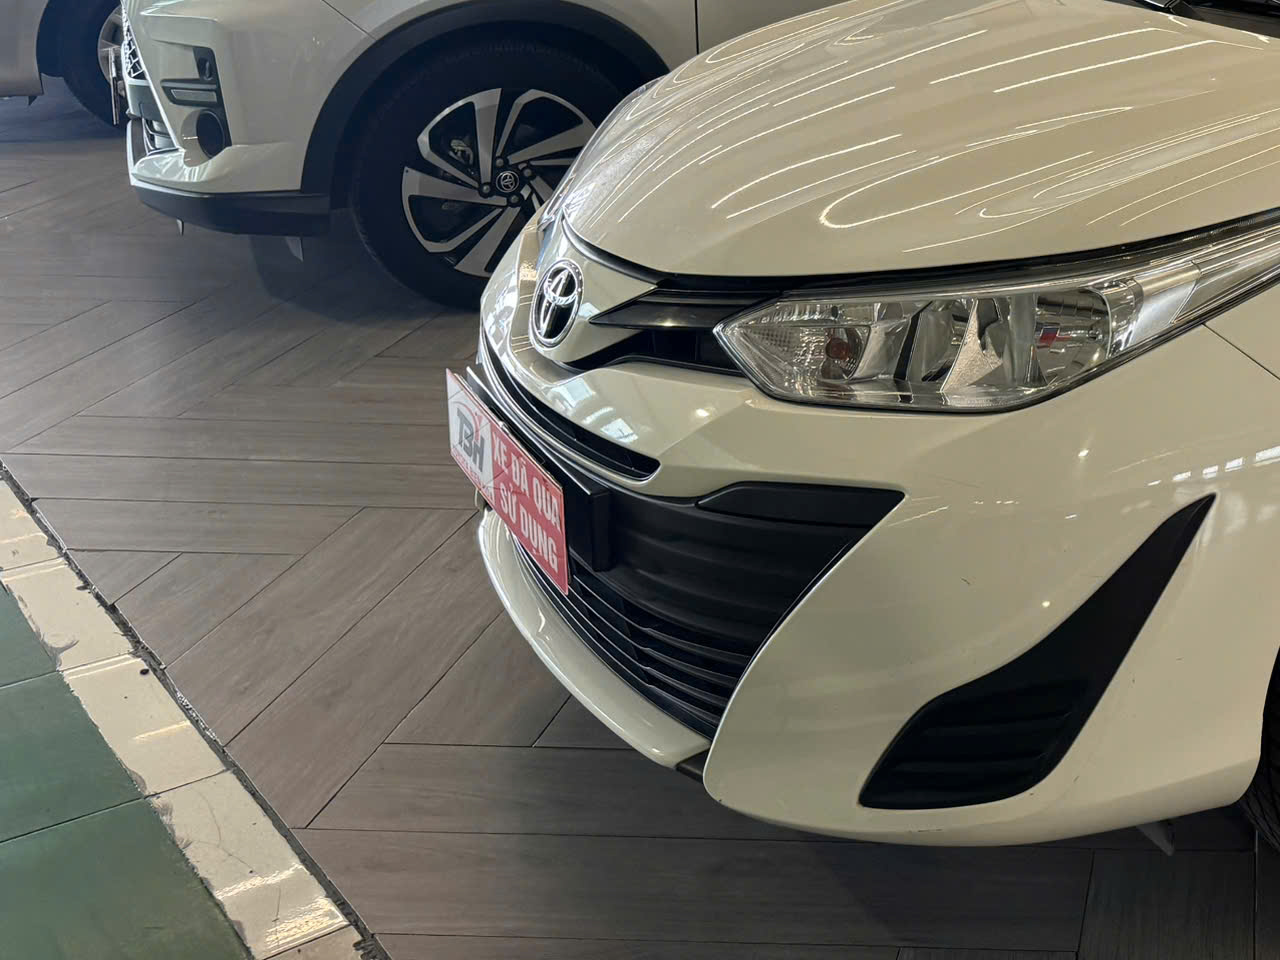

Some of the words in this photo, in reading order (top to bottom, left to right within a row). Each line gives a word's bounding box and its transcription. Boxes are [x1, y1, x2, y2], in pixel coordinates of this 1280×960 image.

[492, 431, 508, 474] XE
[532, 476, 562, 534] QUA
[519, 503, 559, 574] DỤNG
